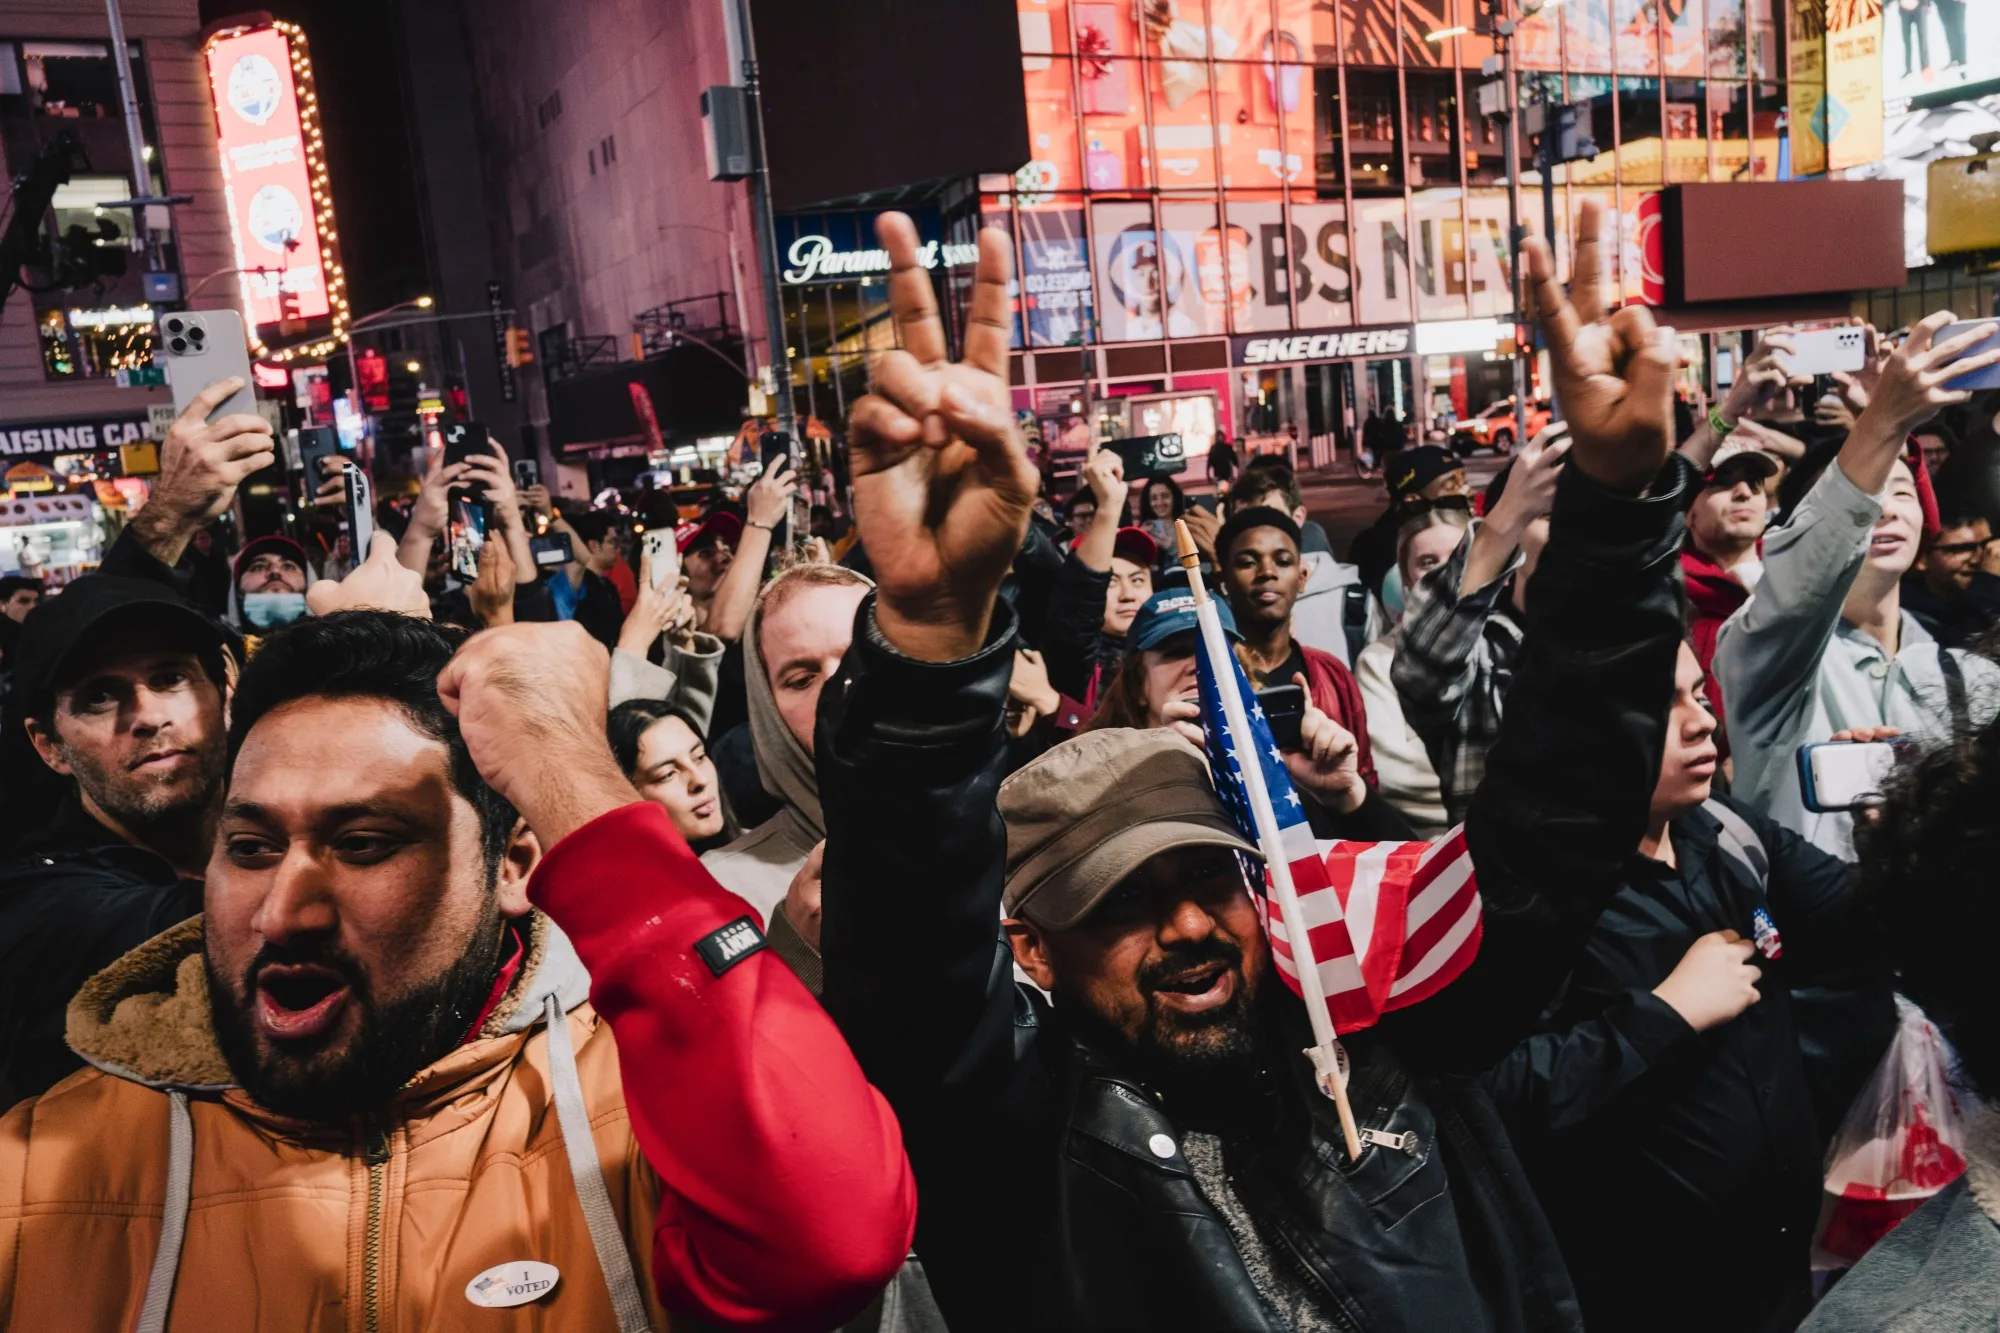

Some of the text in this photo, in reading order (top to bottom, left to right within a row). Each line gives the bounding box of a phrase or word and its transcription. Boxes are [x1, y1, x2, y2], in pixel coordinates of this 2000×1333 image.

[783, 234, 938, 284] Paramnt
[1380, 217, 1535, 300] NE
[1243, 328, 1410, 364] SKECHERS
[506, 1280, 550, 1296] VOTED
[524, 1271, 529, 1281] I
